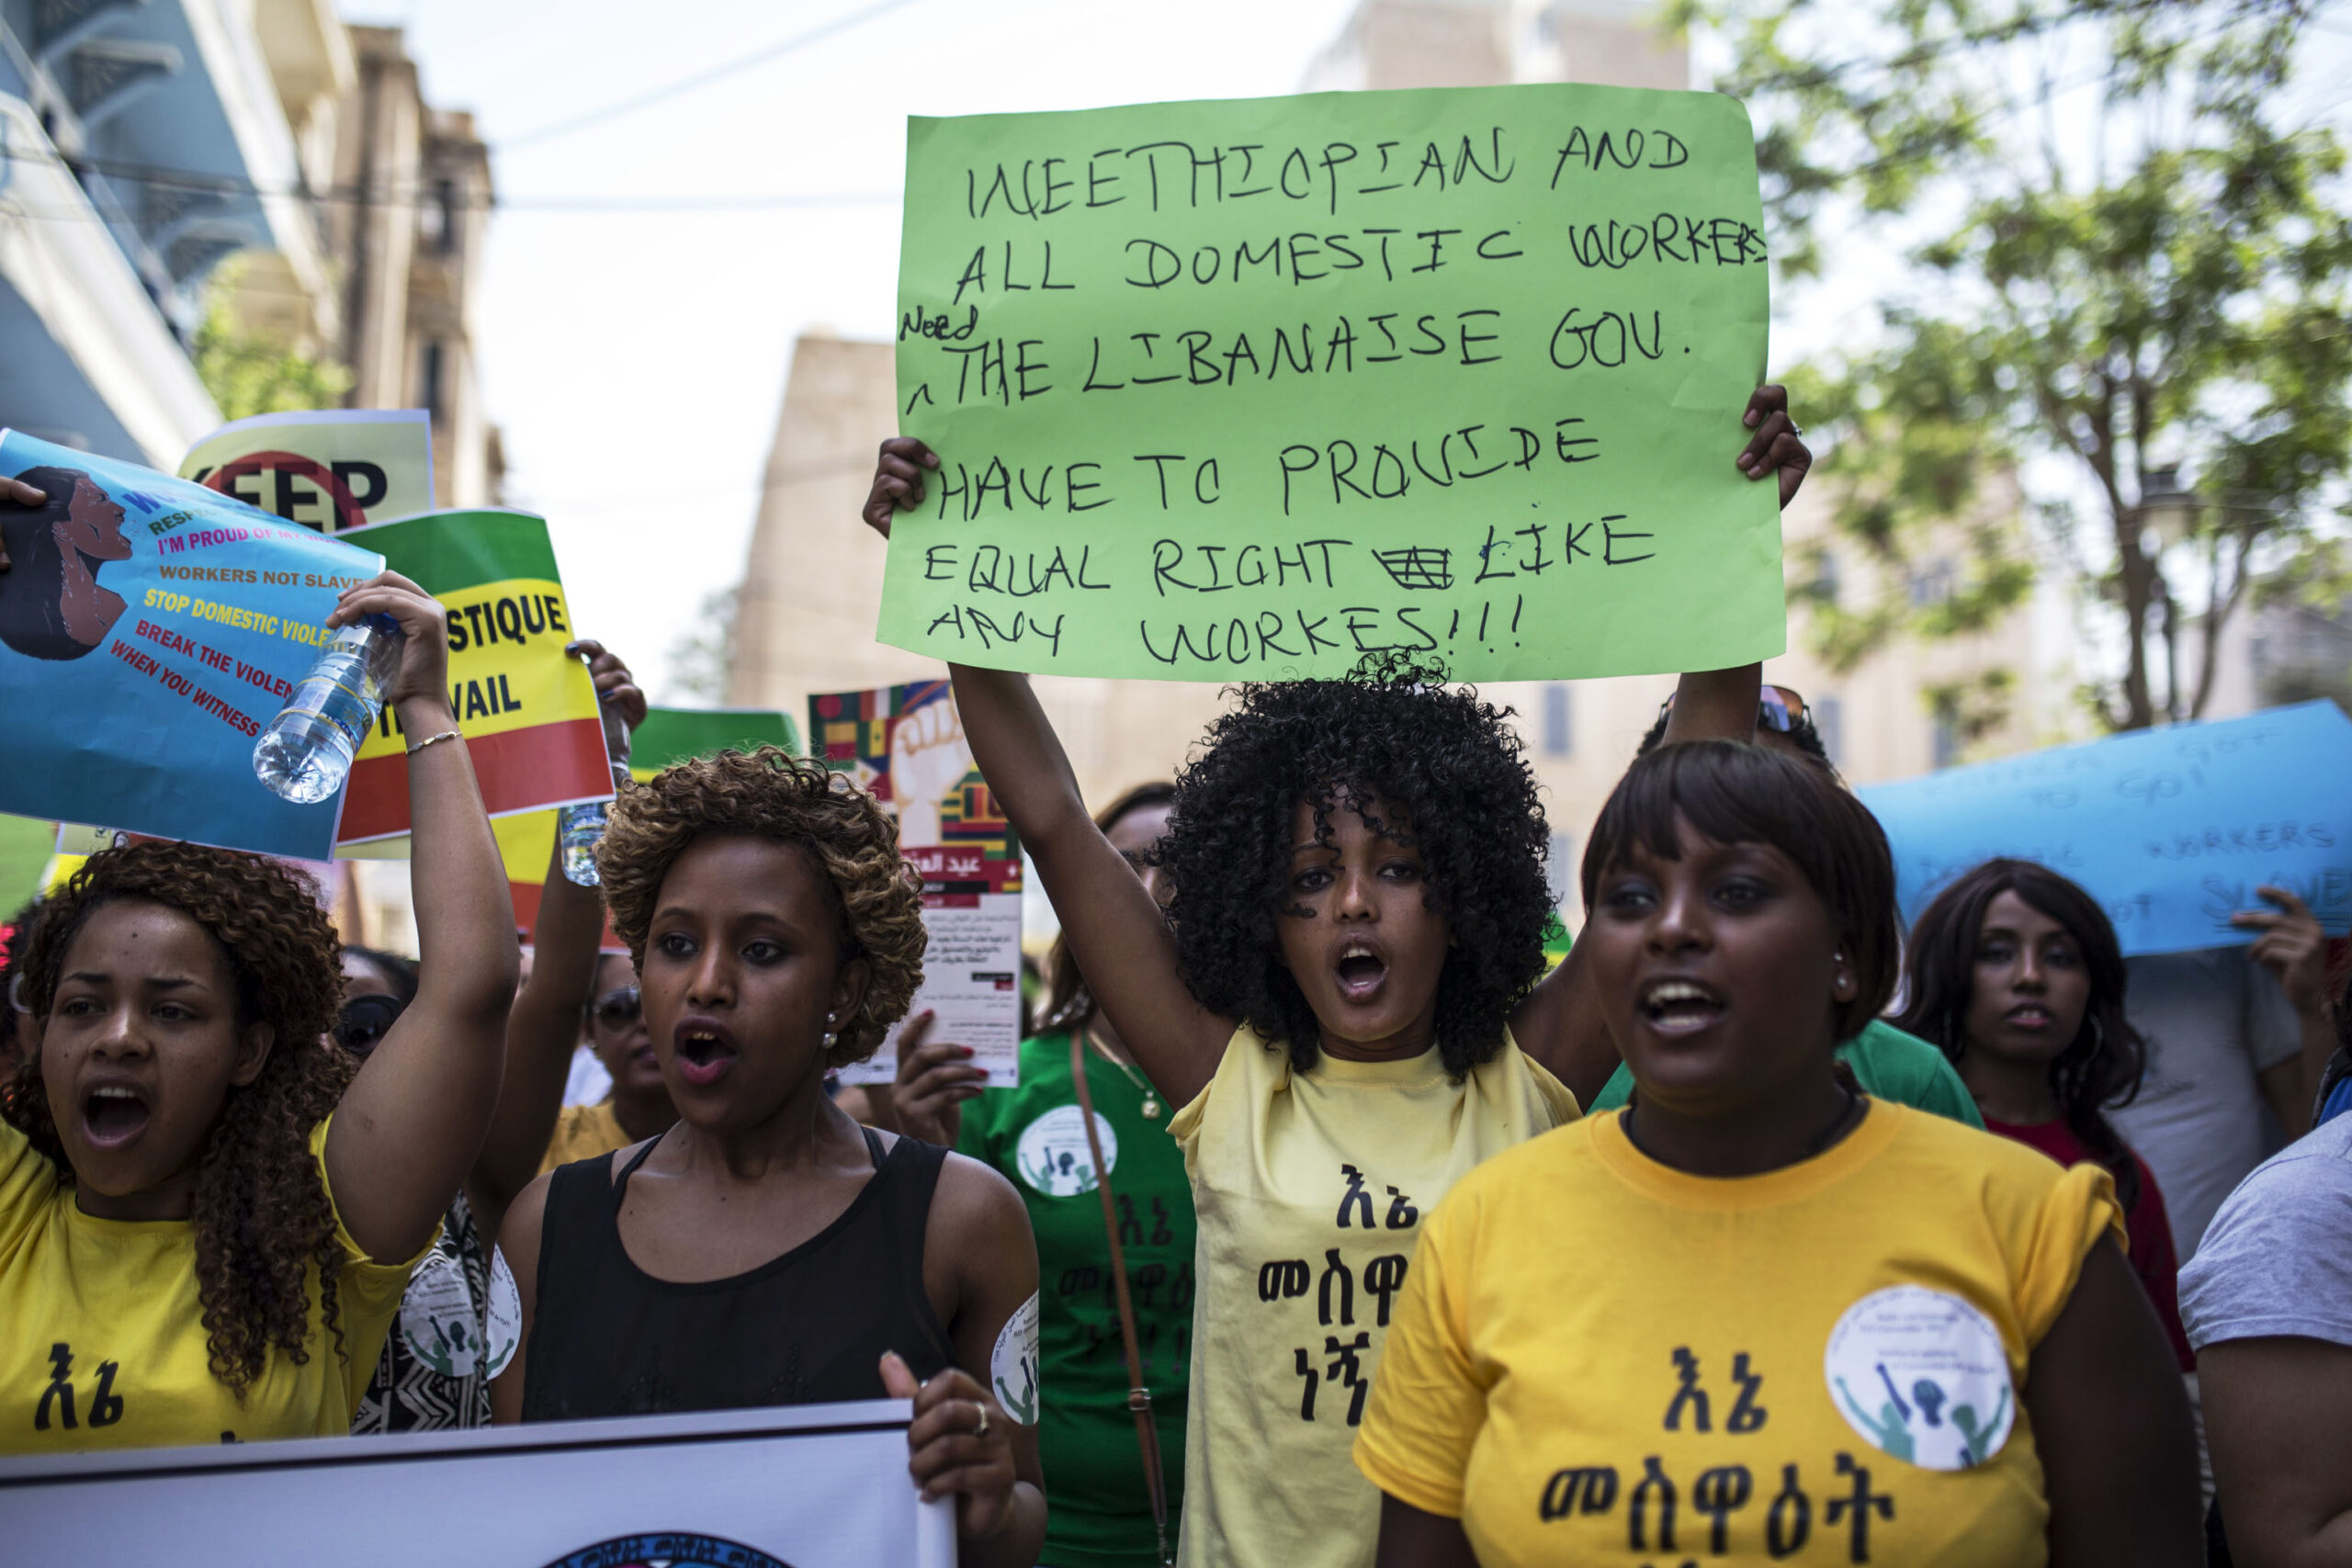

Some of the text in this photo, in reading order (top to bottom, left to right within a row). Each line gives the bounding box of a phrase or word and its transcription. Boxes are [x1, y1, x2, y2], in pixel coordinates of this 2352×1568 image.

[1551, 125, 1689, 190] AND
[953, 212, 1769, 306] ALL DOMESTIC WORKERS
[899, 304, 979, 341] Need
[940, 337, 1054, 406] THE
[1082, 310, 1503, 393] LIBANAISE
[938, 418, 1601, 522] HAVE TO PROVIDE
[157, 536, 185, 556] I'M
[188, 527, 248, 550] PROUD
[253, 527, 273, 540] OF
[923, 544, 1112, 597] EQUAL
[1152, 538, 1353, 597] RIGHT
[1474, 514, 1657, 585] LIKE
[158, 565, 364, 589] WORKERS NOT SLAVE
[143, 588, 332, 648] STOP DOMESTIC VIOLE
[446, 594, 567, 653] STIQUE
[926, 604, 1066, 658] ANY
[109, 638, 261, 738] WHEN YOU WITNESS
[134, 619, 293, 699] BREAK THE VIOLEN
[2143, 820, 2335, 861] WORKERS
[1259, 1246, 1409, 1328] መስዋ
